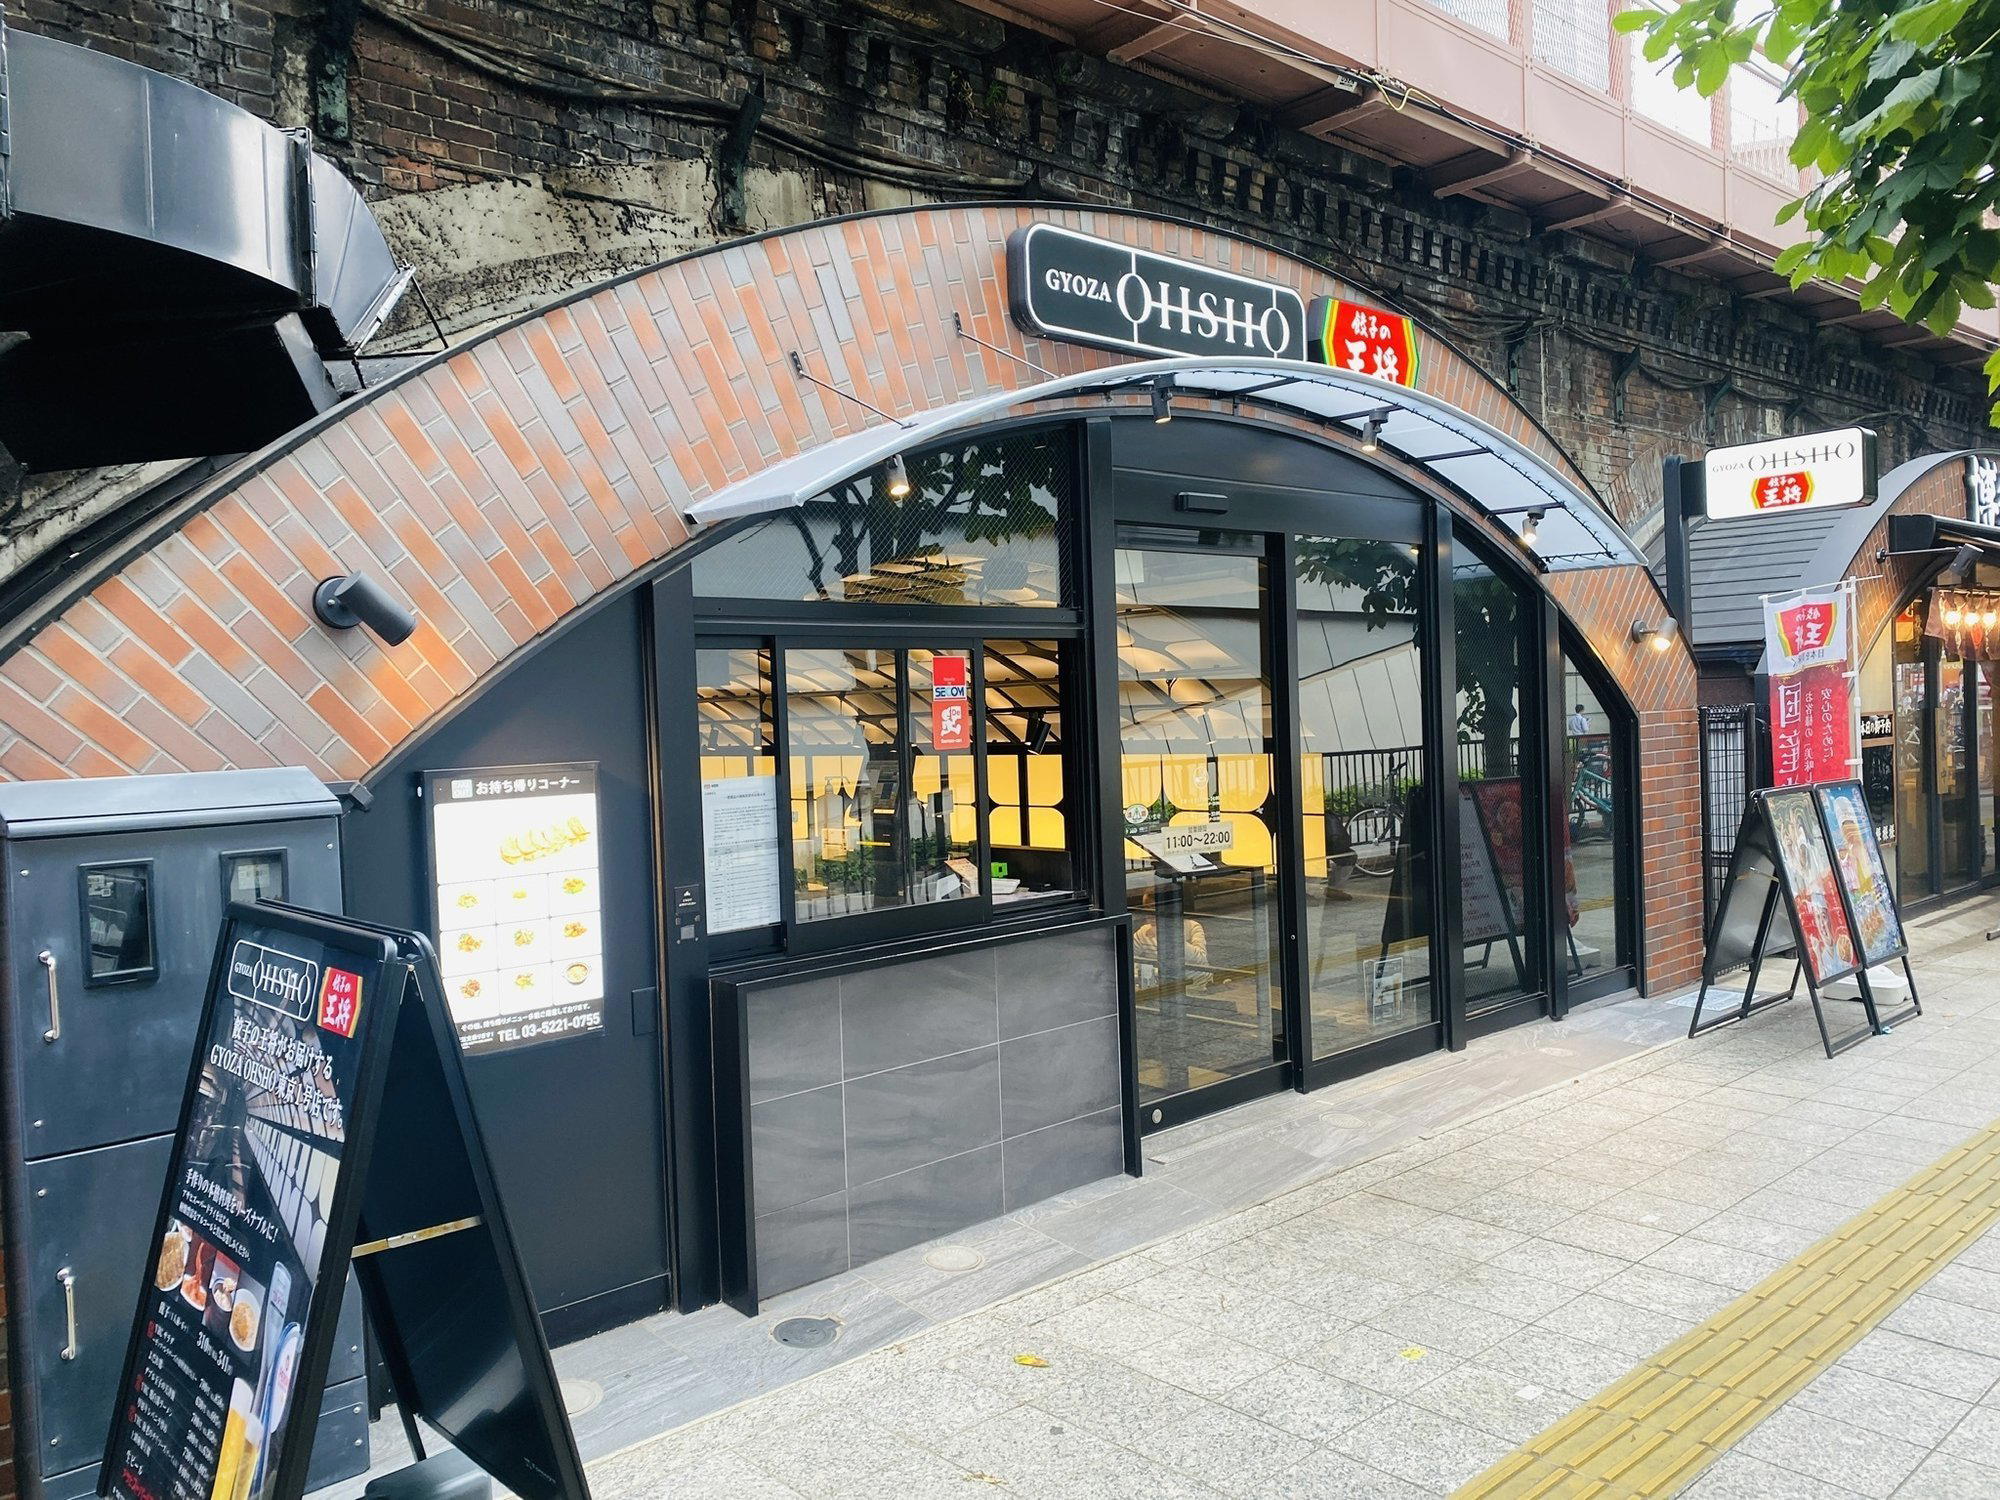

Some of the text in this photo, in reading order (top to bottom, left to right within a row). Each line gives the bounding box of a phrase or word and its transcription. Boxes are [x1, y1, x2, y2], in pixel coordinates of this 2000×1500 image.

[1045, 268, 1291, 353] GYOZA OHSHO
[1351, 310, 1391, 340] 餃子の
[1344, 338, 1399, 384] 王将
[1712, 441, 1855, 473] GYOZA OHSHO
[1763, 485, 1802, 507] 王将
[475, 776, 580, 796] お持ち帰りコーナー
[234, 960, 311, 1005] GYOZA OHSHO
[323, 993, 351, 1032] 王将
[497, 1012, 601, 1043] TEL 03-5221-0755
[231, 1015, 333, 1080] 餃子の王将がお届けする
[210, 1044, 344, 1129] GYOZA OHSHO 東京1号店です。
